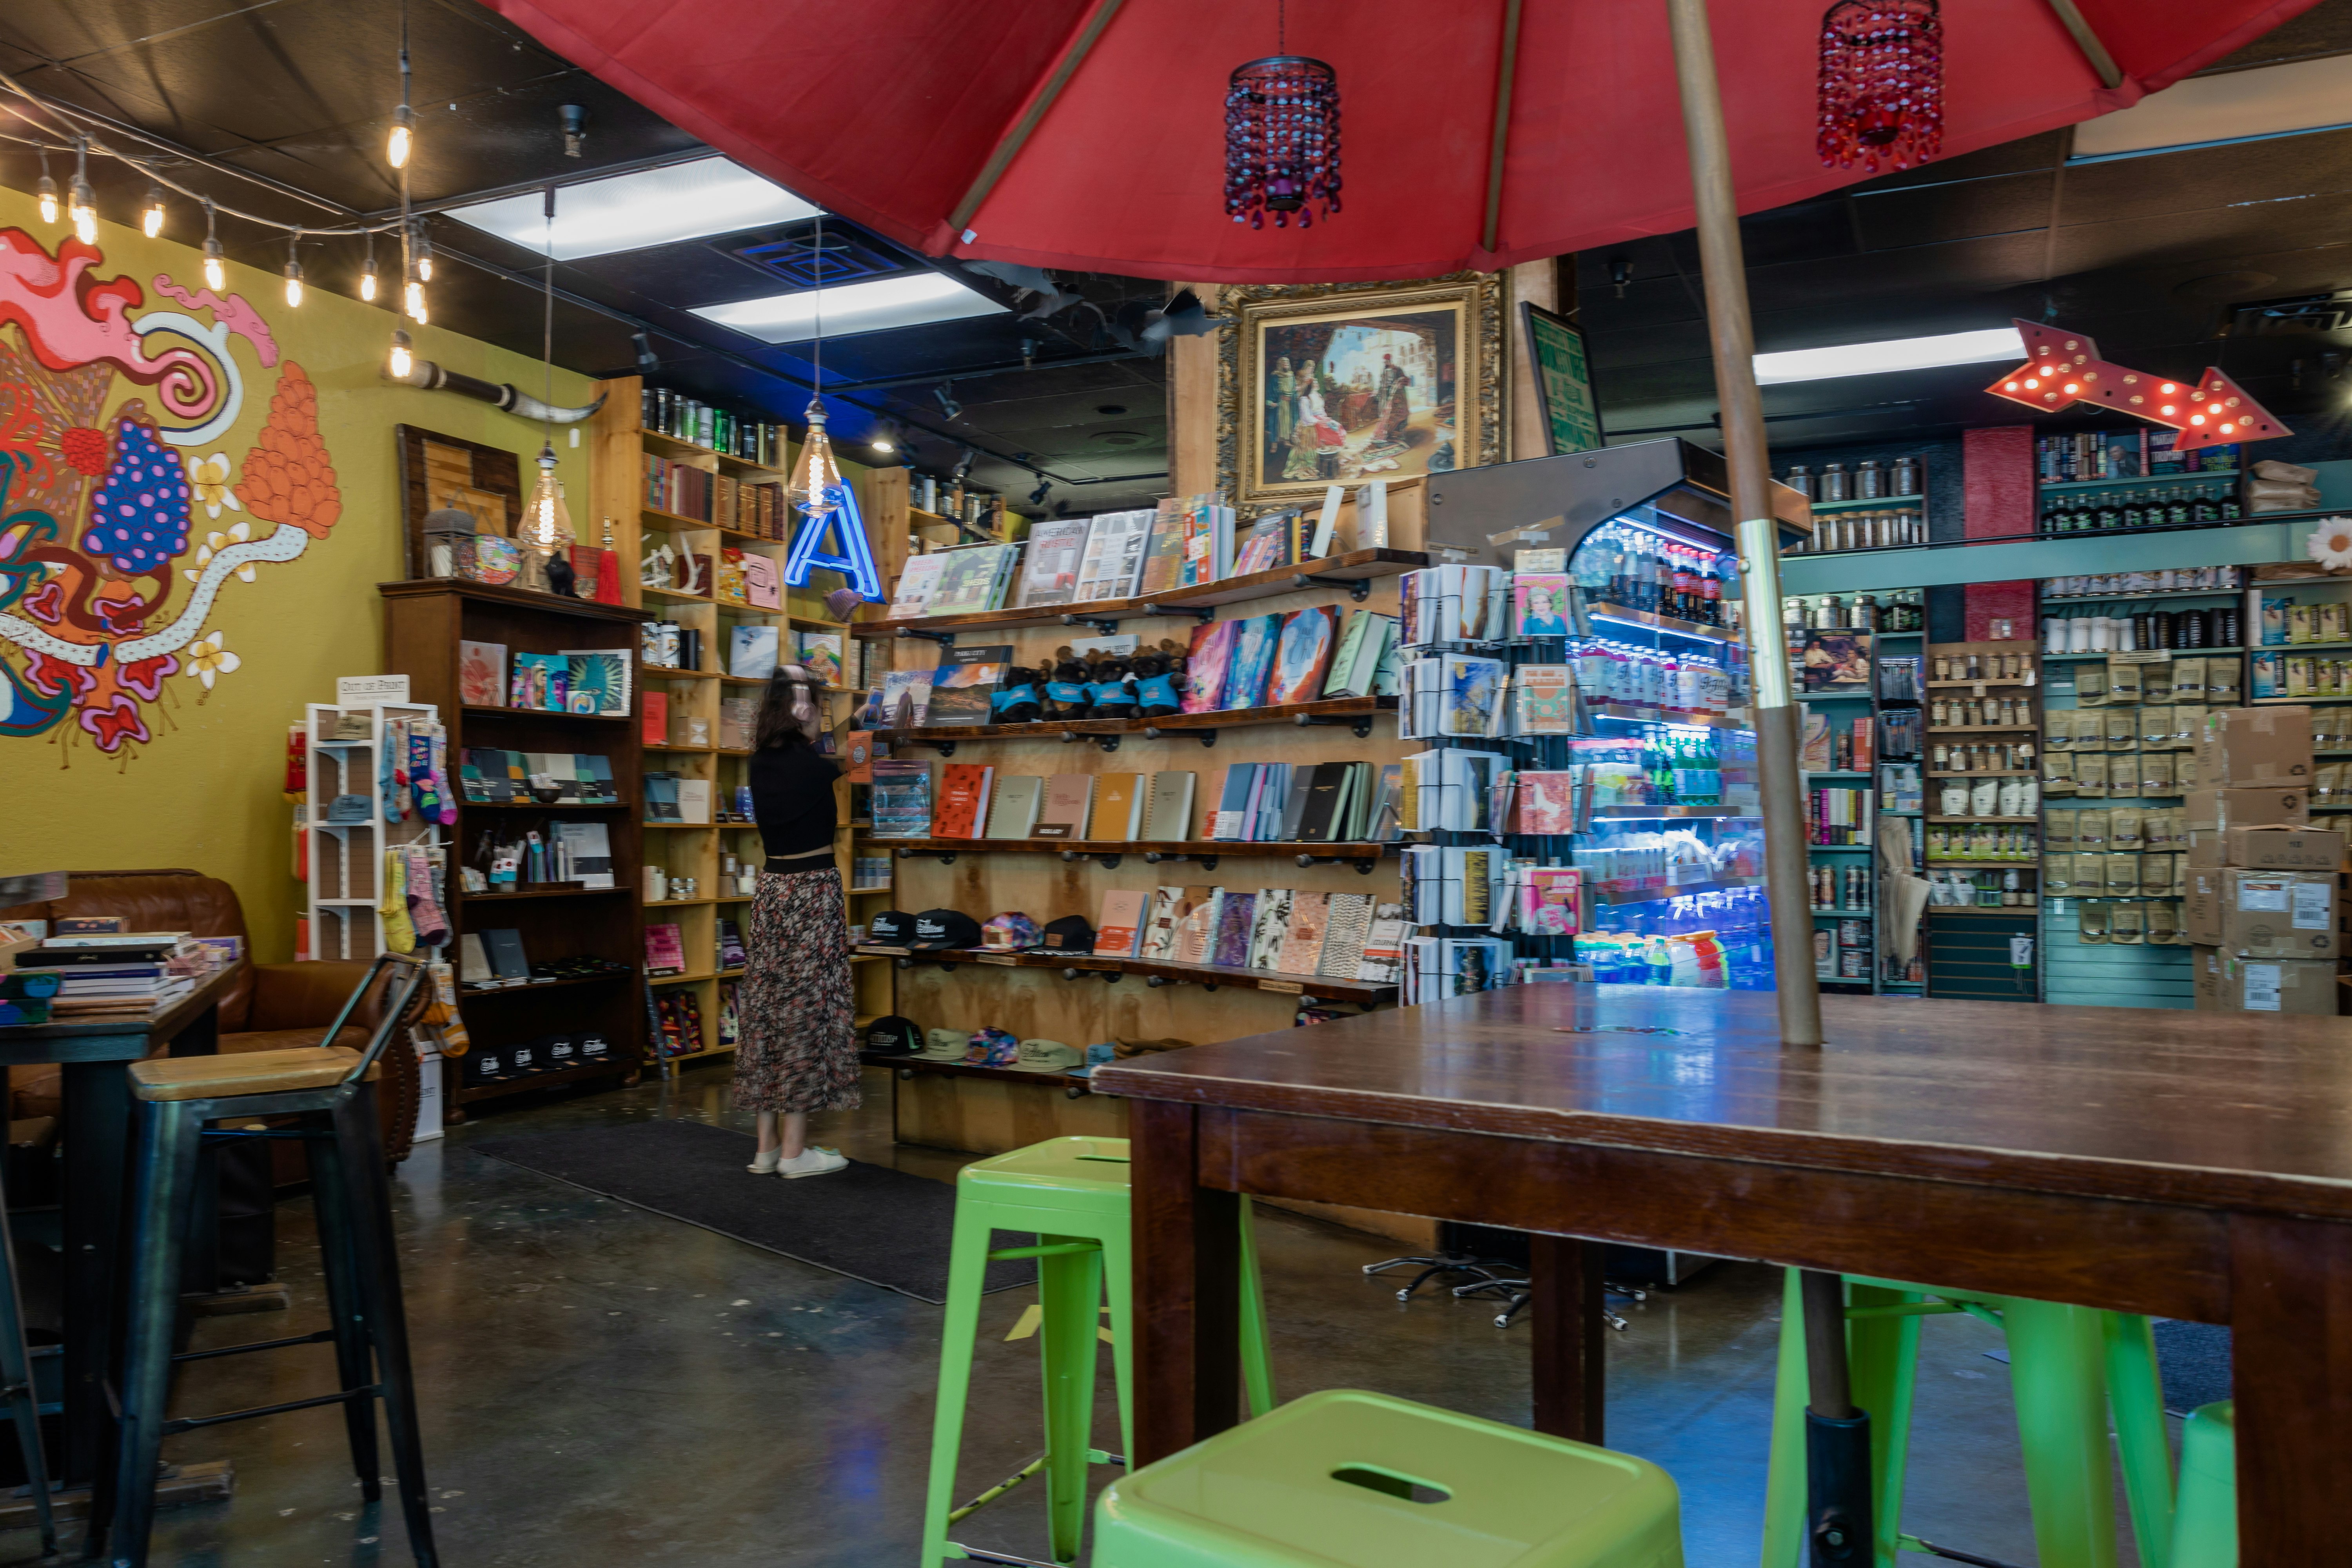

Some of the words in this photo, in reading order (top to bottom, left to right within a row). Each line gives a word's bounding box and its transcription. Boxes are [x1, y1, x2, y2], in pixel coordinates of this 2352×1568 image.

[1035, 526, 1083, 537] AMERICAN
[784, 478, 887, 604] A
[1040, 538, 1076, 548] RUSTIC
[962, 578, 991, 587] SHEDS
[341, 682, 362, 691] OUT
[377, 681, 406, 689] PRINT
[872, 917, 899, 931] Atticus
[916, 919, 945, 933] Atticus
